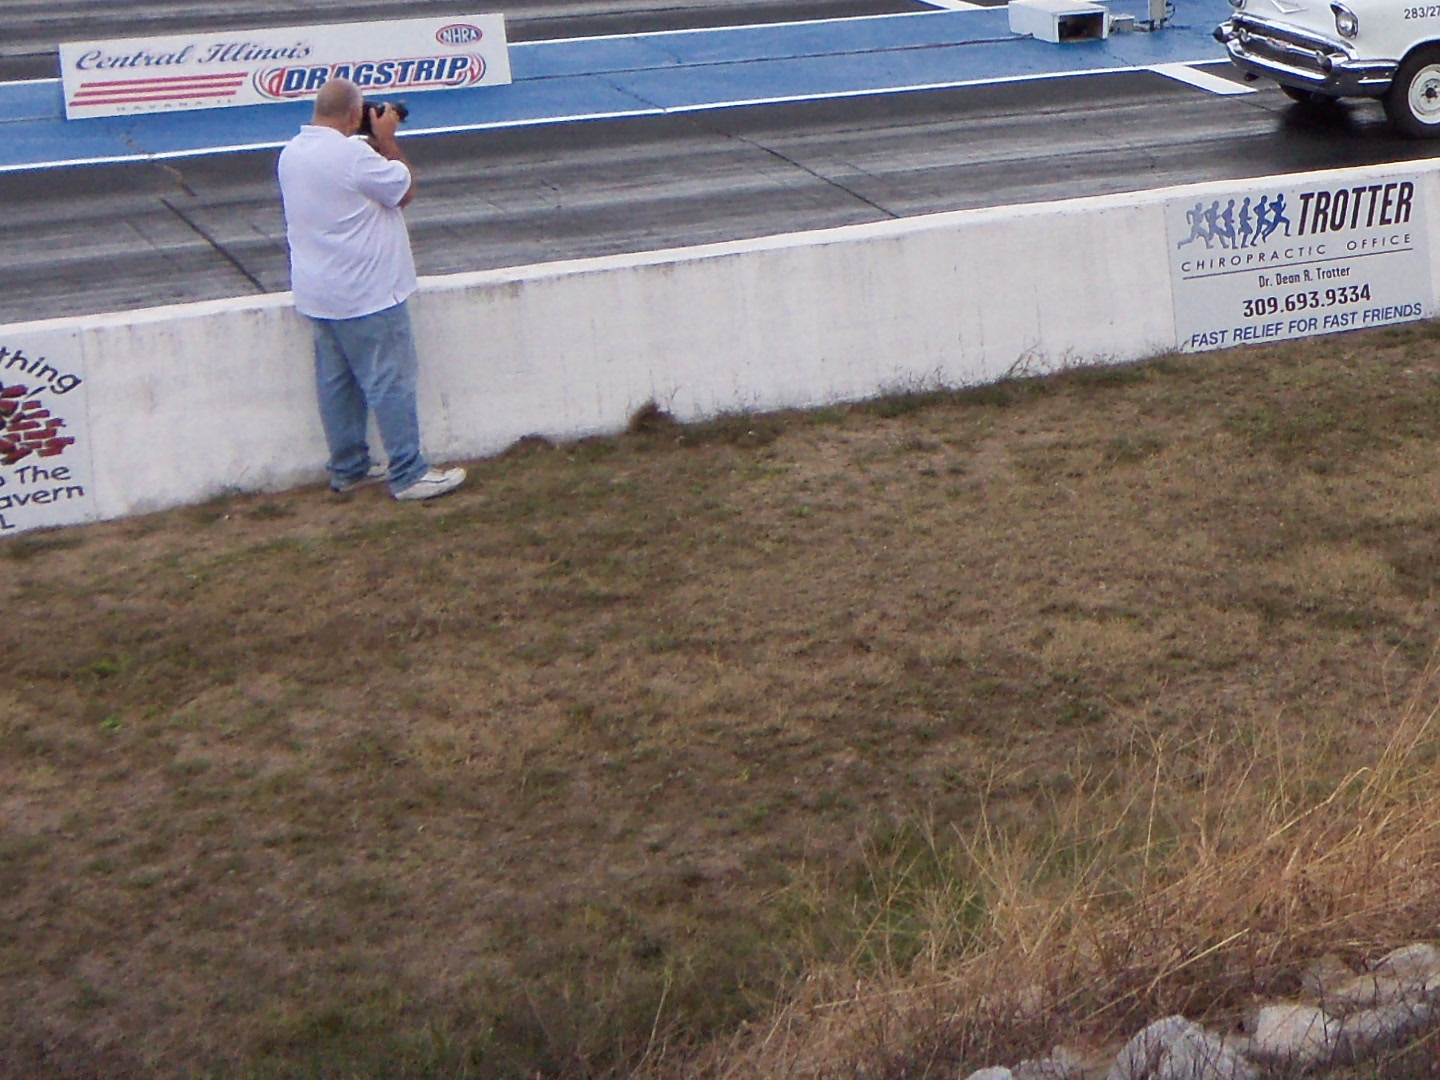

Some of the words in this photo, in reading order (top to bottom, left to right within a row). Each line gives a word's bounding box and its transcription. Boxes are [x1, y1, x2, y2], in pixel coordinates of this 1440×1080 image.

[441, 28, 478, 44] NHRA
[76, 45, 194, 70] Central
[198, 41, 314, 64] Illinois
[282, 57, 470, 92] DRAGSTRIP
[1298, 182, 1414, 236] TROTTER
[1181, 245, 1326, 272] CHIROPRACTIC
[1347, 234, 1410, 250] OFFICE
[1258, 276, 1272, 288] Dr.
[1276, 273, 1300, 286] Dean
[1304, 270, 1313, 282] R.
[1317, 267, 1351, 280] Trotter
[1243, 283, 1371, 318] 309.693.9334
[1191, 330, 1228, 348] FAST
[1233, 322, 1283, 342] RELIEF
[1288, 318, 1318, 334] FOR
[1323, 311, 1358, 329] FAST
[1362, 303, 1422, 323] FRIENDS
[14, 465, 71, 484] The
